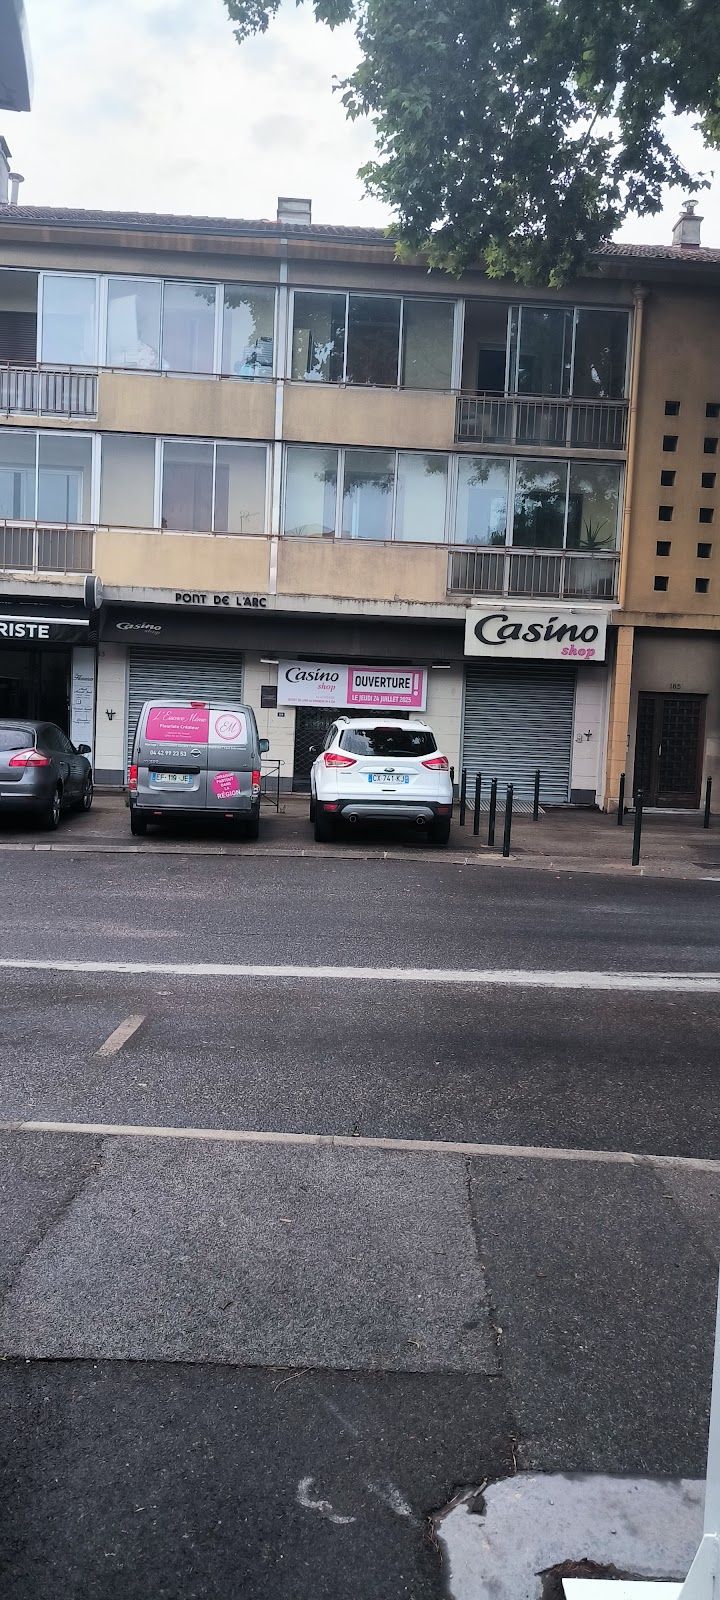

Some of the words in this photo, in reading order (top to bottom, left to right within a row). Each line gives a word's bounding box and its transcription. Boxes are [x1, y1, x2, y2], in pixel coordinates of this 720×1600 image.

[175, 593, 207, 604] PONT
[213, 595, 230, 605] DE
[236, 596, 267, 607] L'ARC
[0, 622, 50, 638] RISTE
[116, 621, 162, 631] Casino
[473, 613, 599, 646] Casino
[561, 644, 596, 660] shop
[285, 667, 340, 683] Casino
[355, 675, 411, 689] OUVERTURE
[317, 682, 336, 692] shop
[359, 694, 373, 702] JEUDI
[380, 695, 399, 703] JUILLET
[400, 696, 412, 704] 2025
[217, 789, 241, 799] RÉGION
